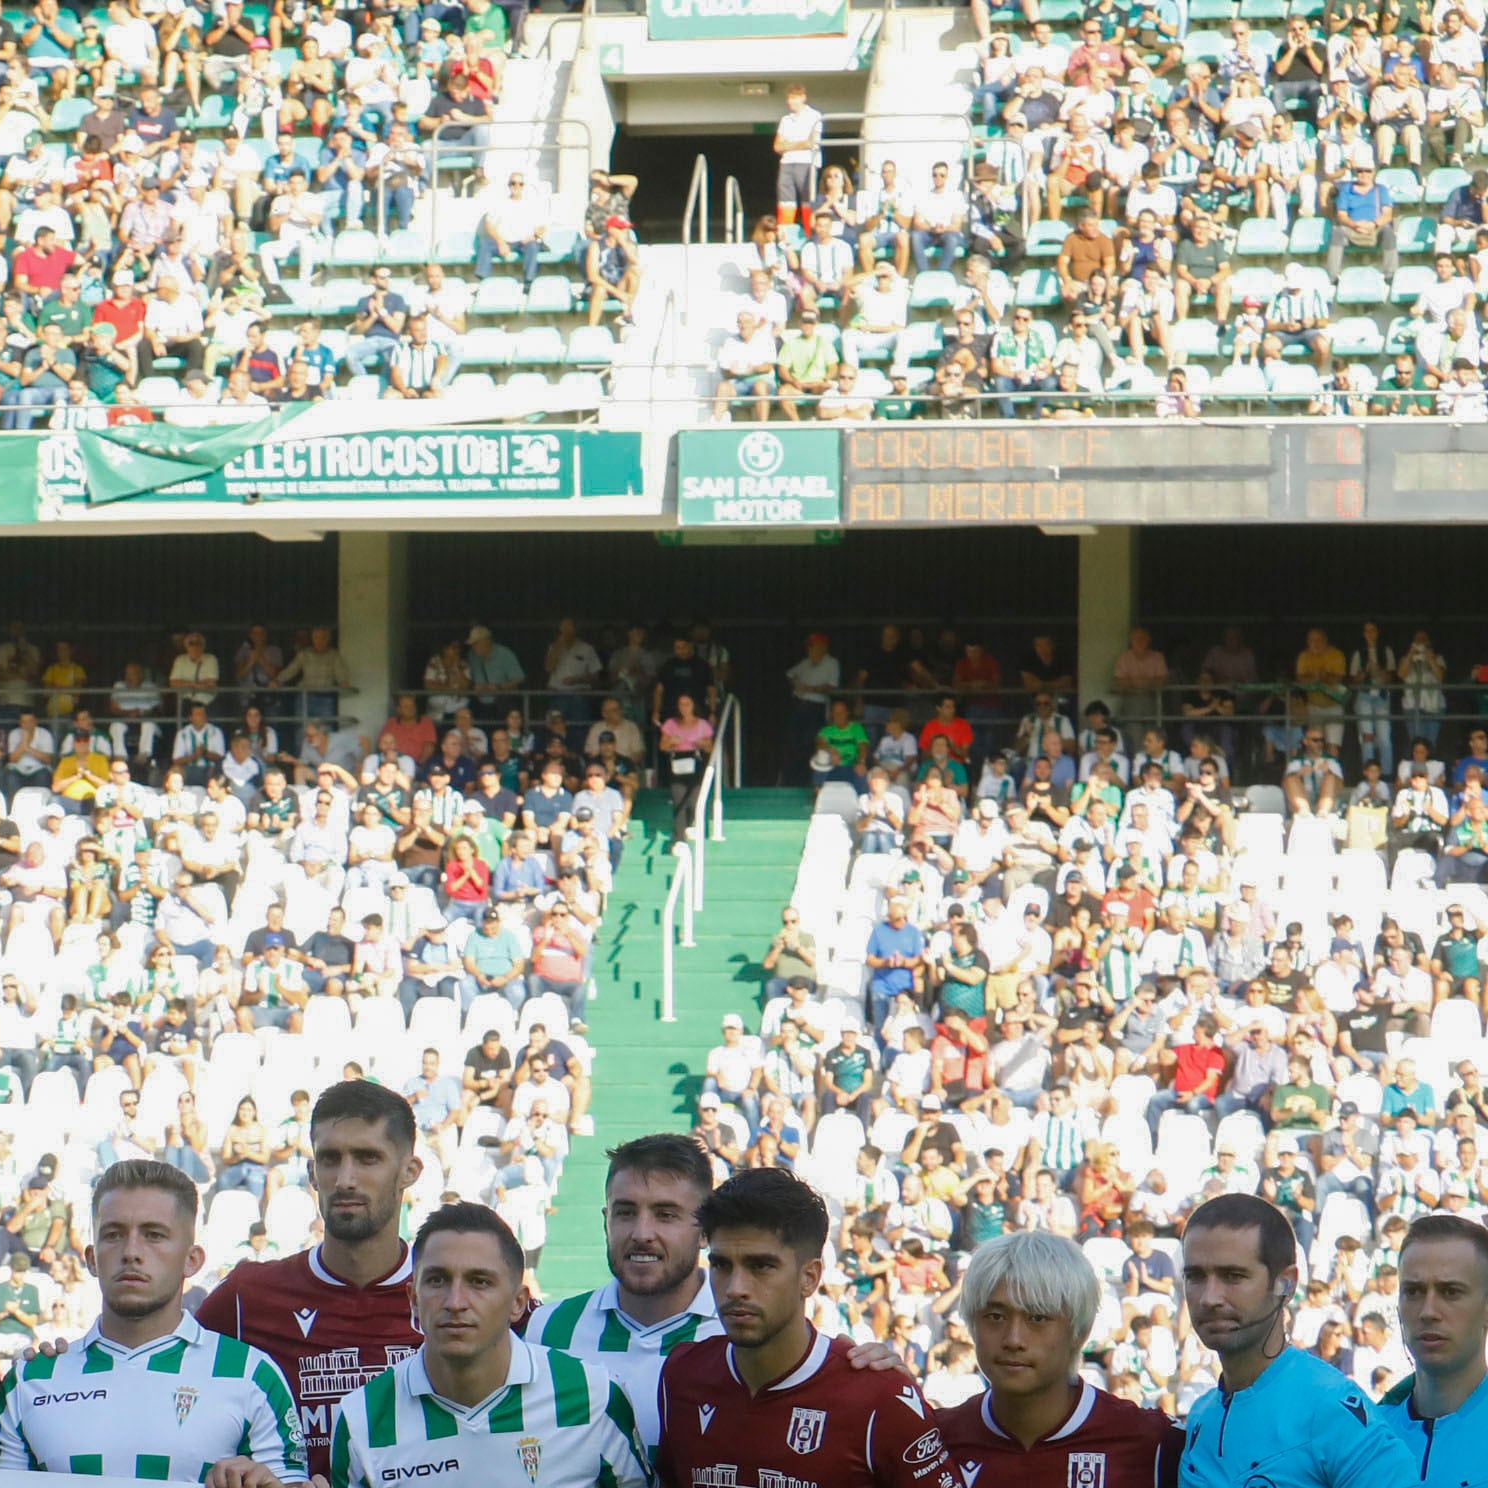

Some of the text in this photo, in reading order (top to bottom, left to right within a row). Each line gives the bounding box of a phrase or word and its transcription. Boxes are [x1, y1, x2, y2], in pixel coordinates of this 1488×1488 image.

[1059, 428, 1111, 466] CF
[1335, 427, 1361, 464] 0
[682, 475, 835, 499] SAN RAFAEL
[849, 482, 1085, 521] AD MERIDA
[1335, 479, 1362, 518] 0
[713, 498, 803, 521] MOTOR
[33, 1389, 107, 1406] GIVOVA
[381, 1459, 459, 1481] GIVOVA
